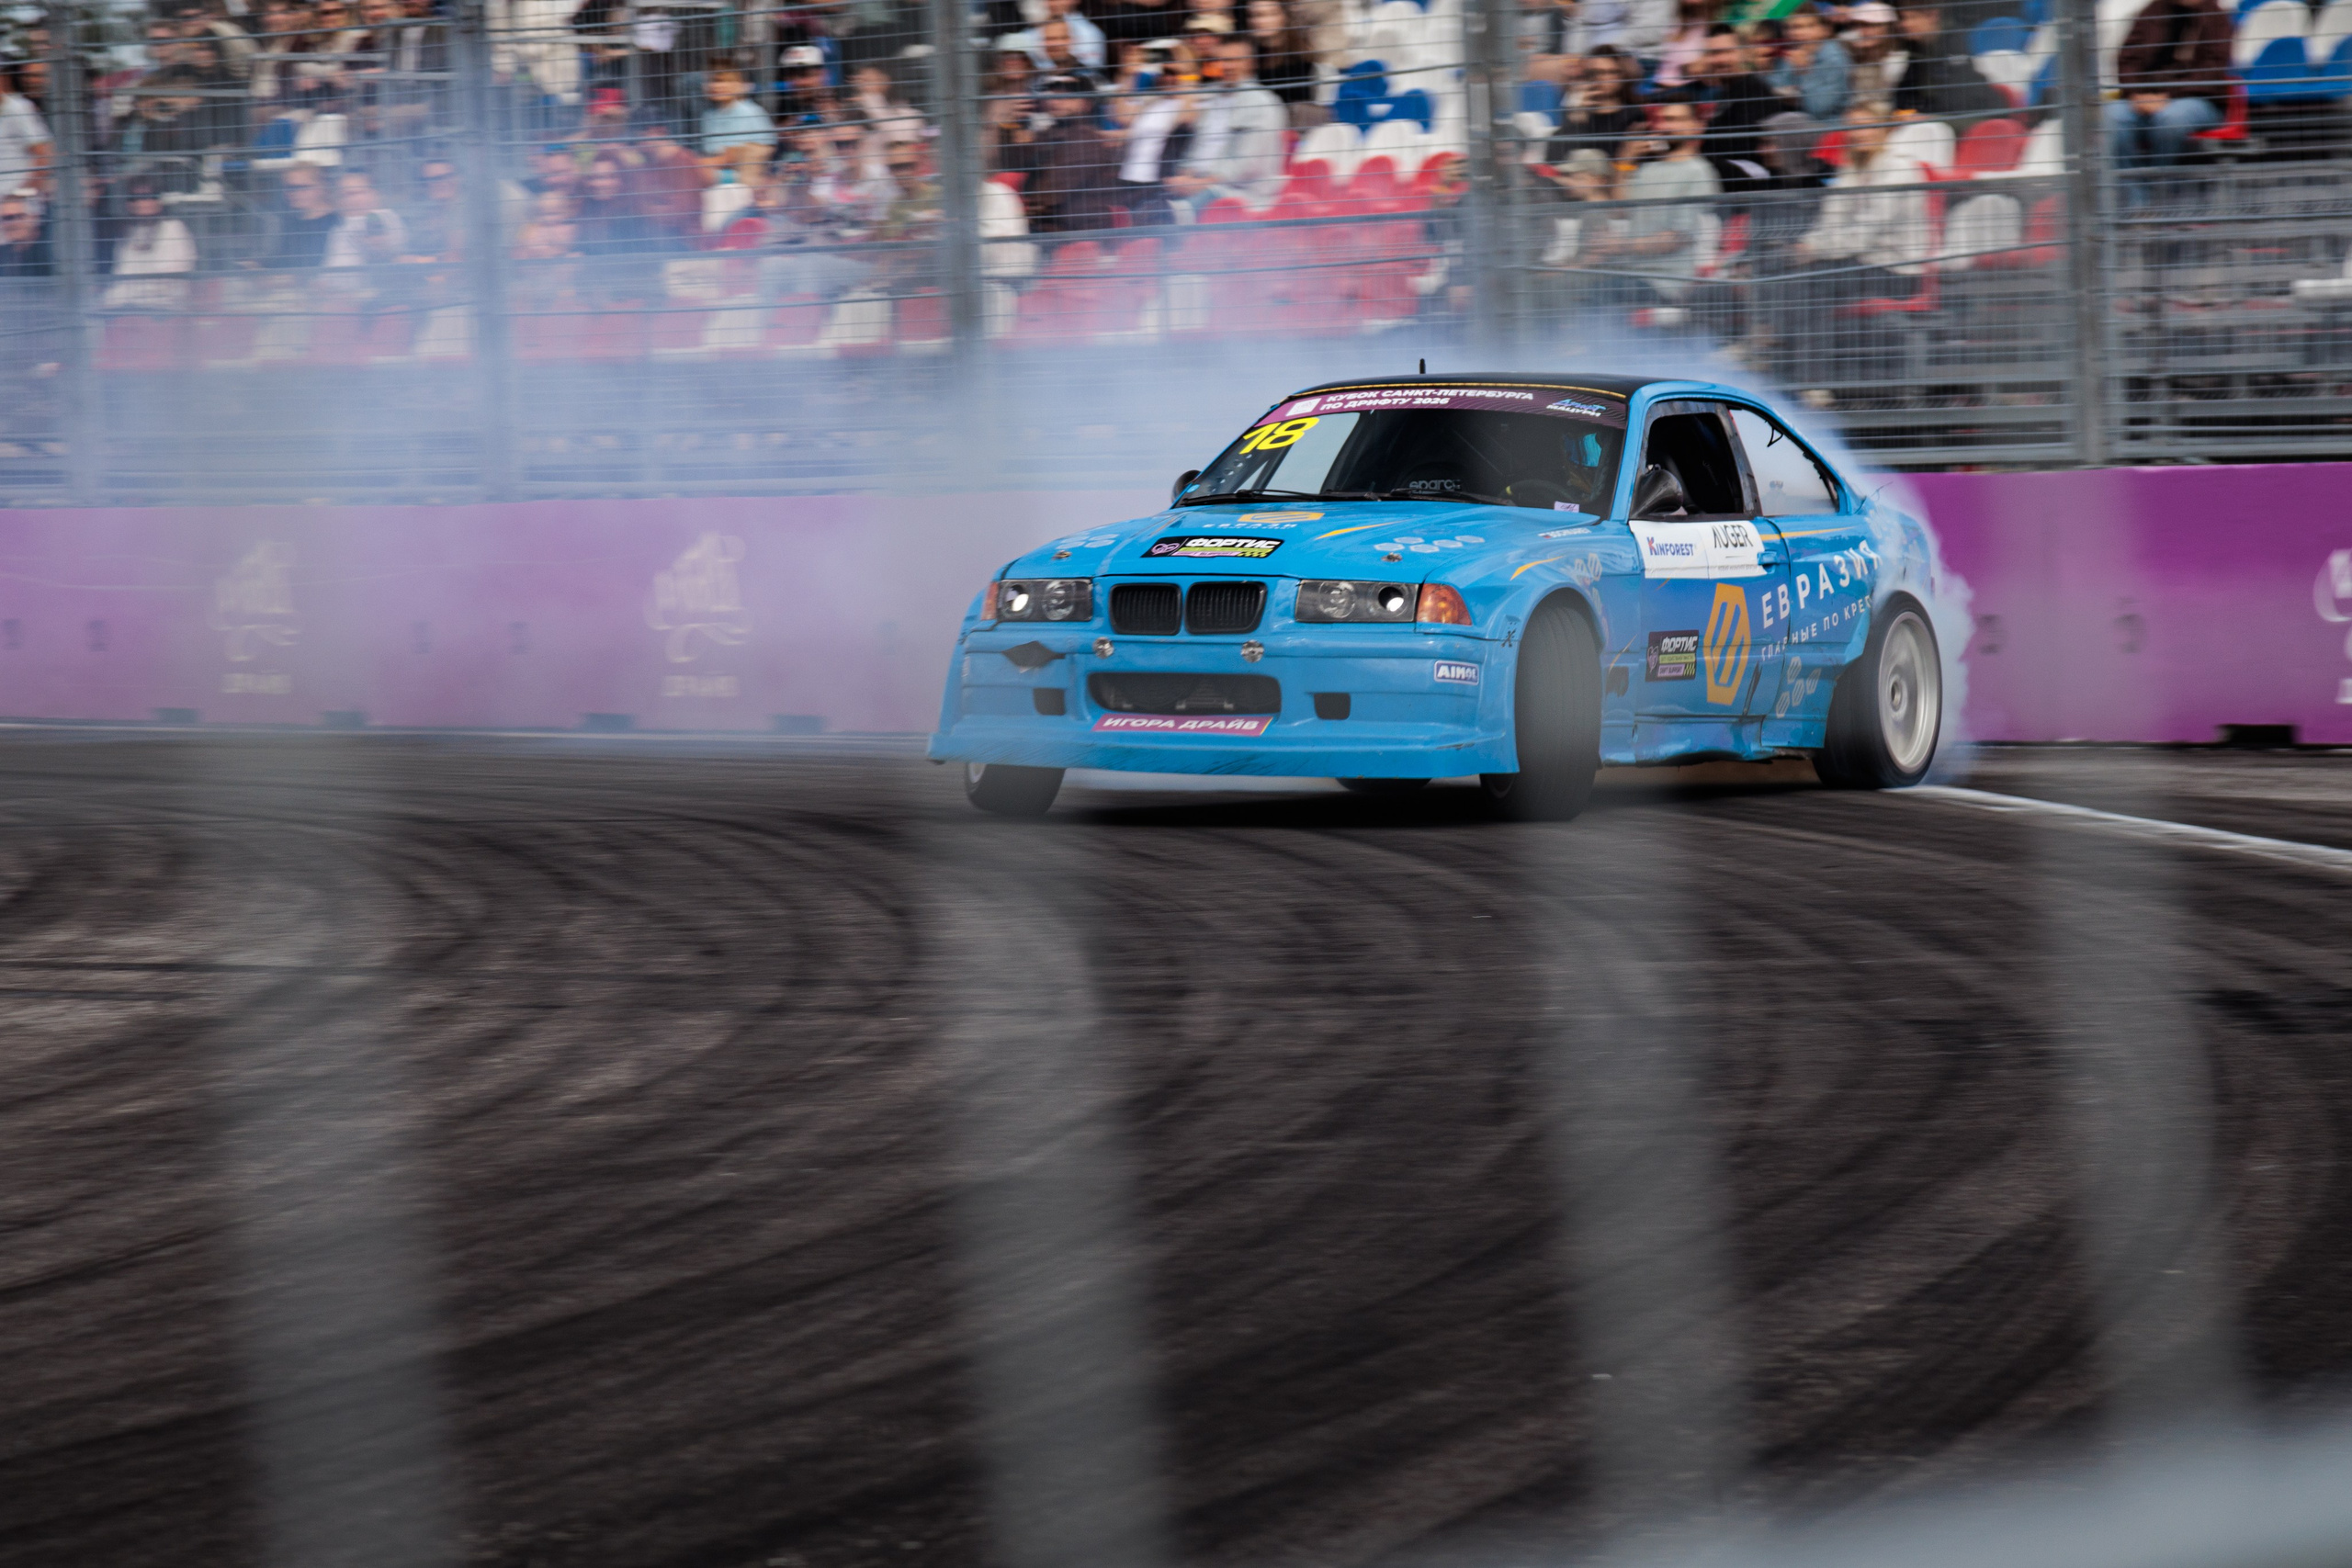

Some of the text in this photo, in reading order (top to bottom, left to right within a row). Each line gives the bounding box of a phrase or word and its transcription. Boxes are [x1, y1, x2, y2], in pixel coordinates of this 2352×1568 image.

[1327, 389, 1533, 402] КУБОК САНКТ-ПЕТЕРБУРГА
[1319, 397, 1450, 411] ПО ДРИФТУ 2026
[1238, 417, 1319, 455] 18
[1185, 538, 1281, 548] ФОРТИС
[1761, 540, 1883, 629] ЕВРАЗИЯ
[1824, 612, 1839, 631] ПО
[1661, 636, 1698, 652] ФОРТИС
[1102, 717, 1260, 730] ИГОРА ДРАЙВ
